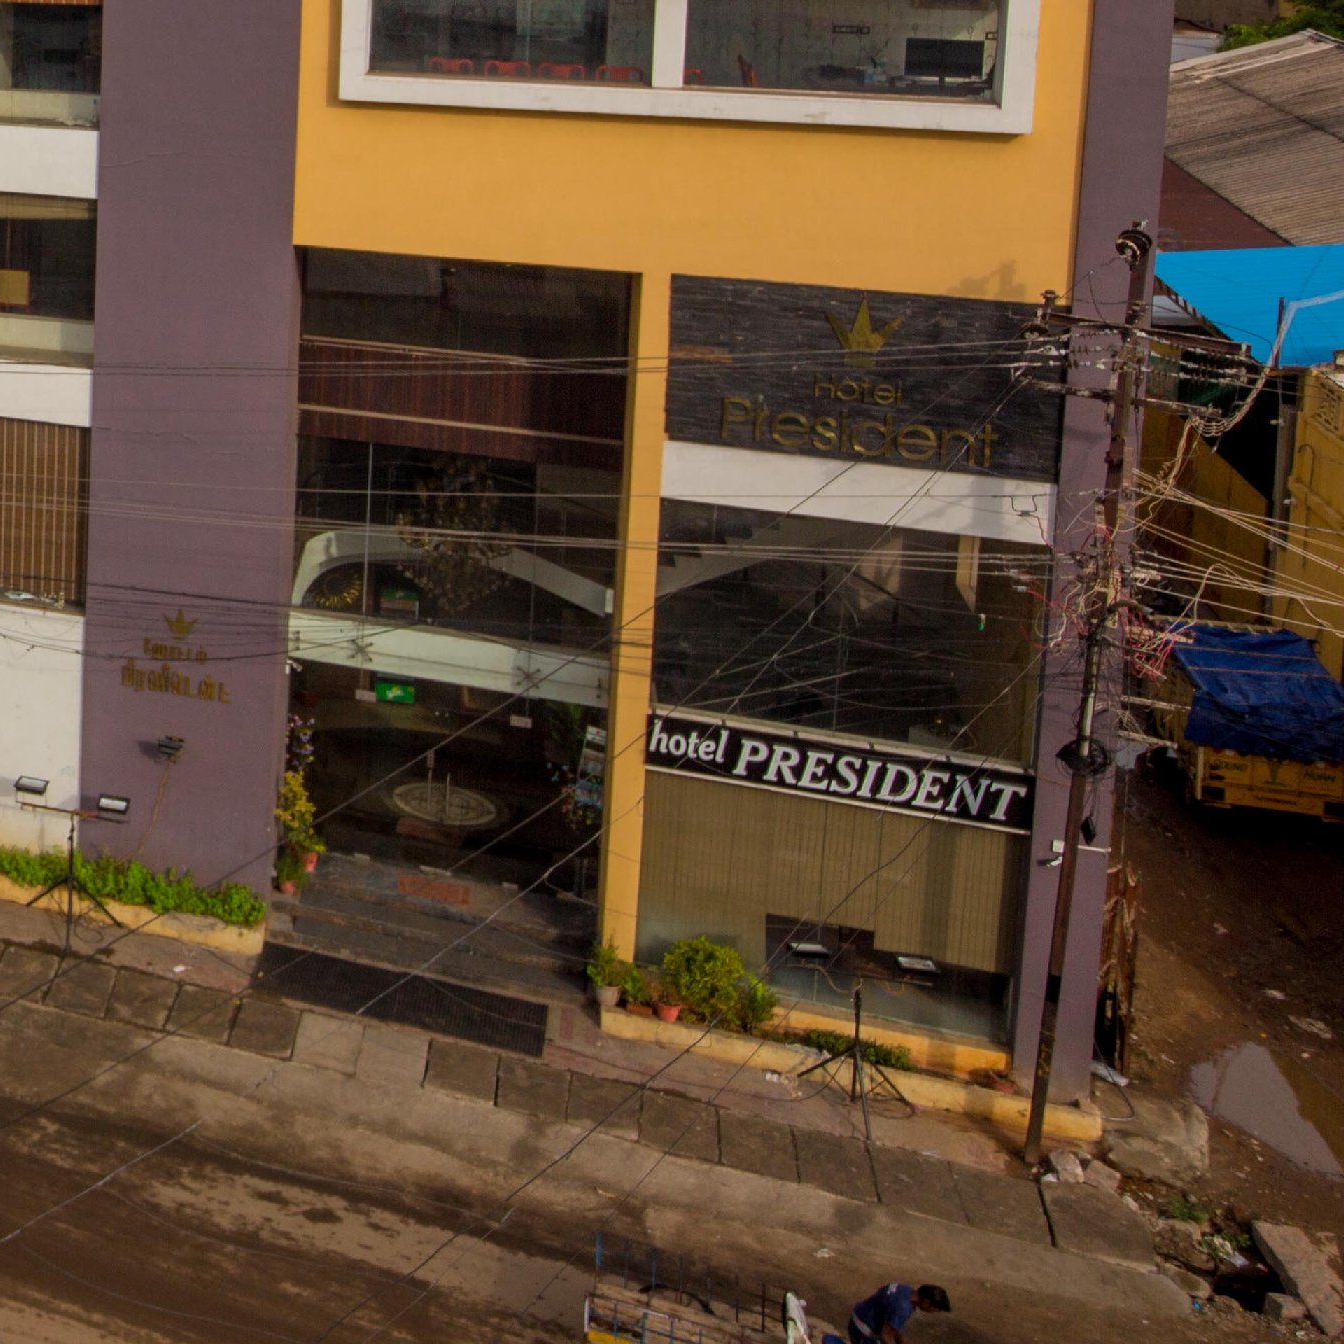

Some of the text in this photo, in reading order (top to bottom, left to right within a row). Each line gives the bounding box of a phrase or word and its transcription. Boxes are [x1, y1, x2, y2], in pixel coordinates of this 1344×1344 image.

[721, 394, 999, 469] President
[649, 719, 1027, 821] hotel PRESIDENT
